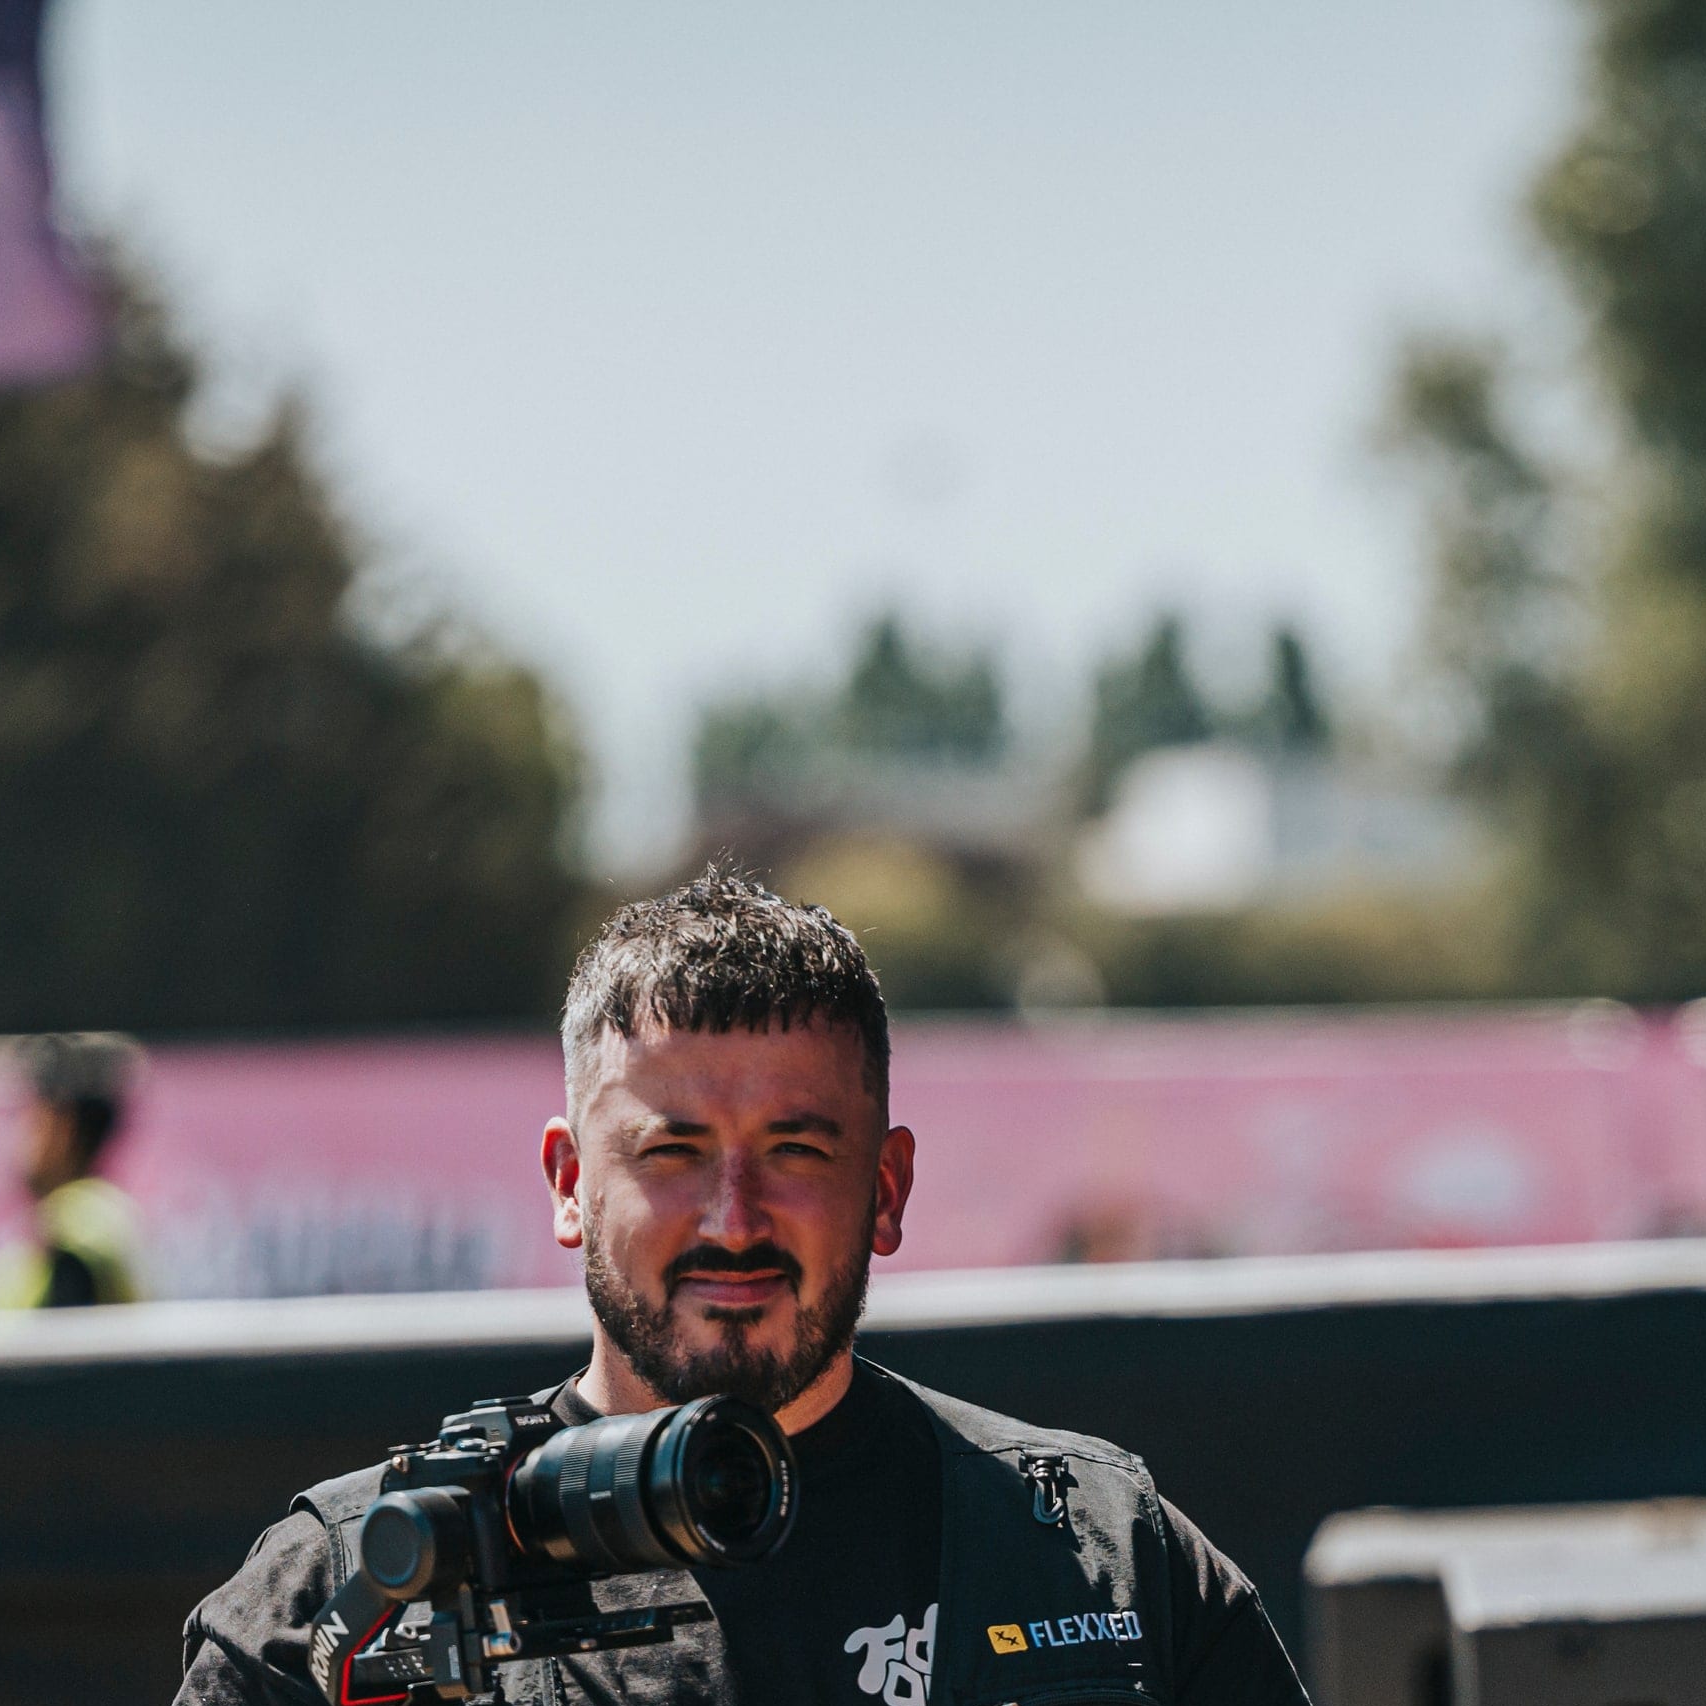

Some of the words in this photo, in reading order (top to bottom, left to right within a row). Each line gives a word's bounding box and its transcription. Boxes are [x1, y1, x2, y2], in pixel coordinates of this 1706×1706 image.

[515, 1413, 551, 1426] SONY
[1028, 1611, 1142, 1648] FLEXXED
[311, 1610, 349, 1692] RONIN
